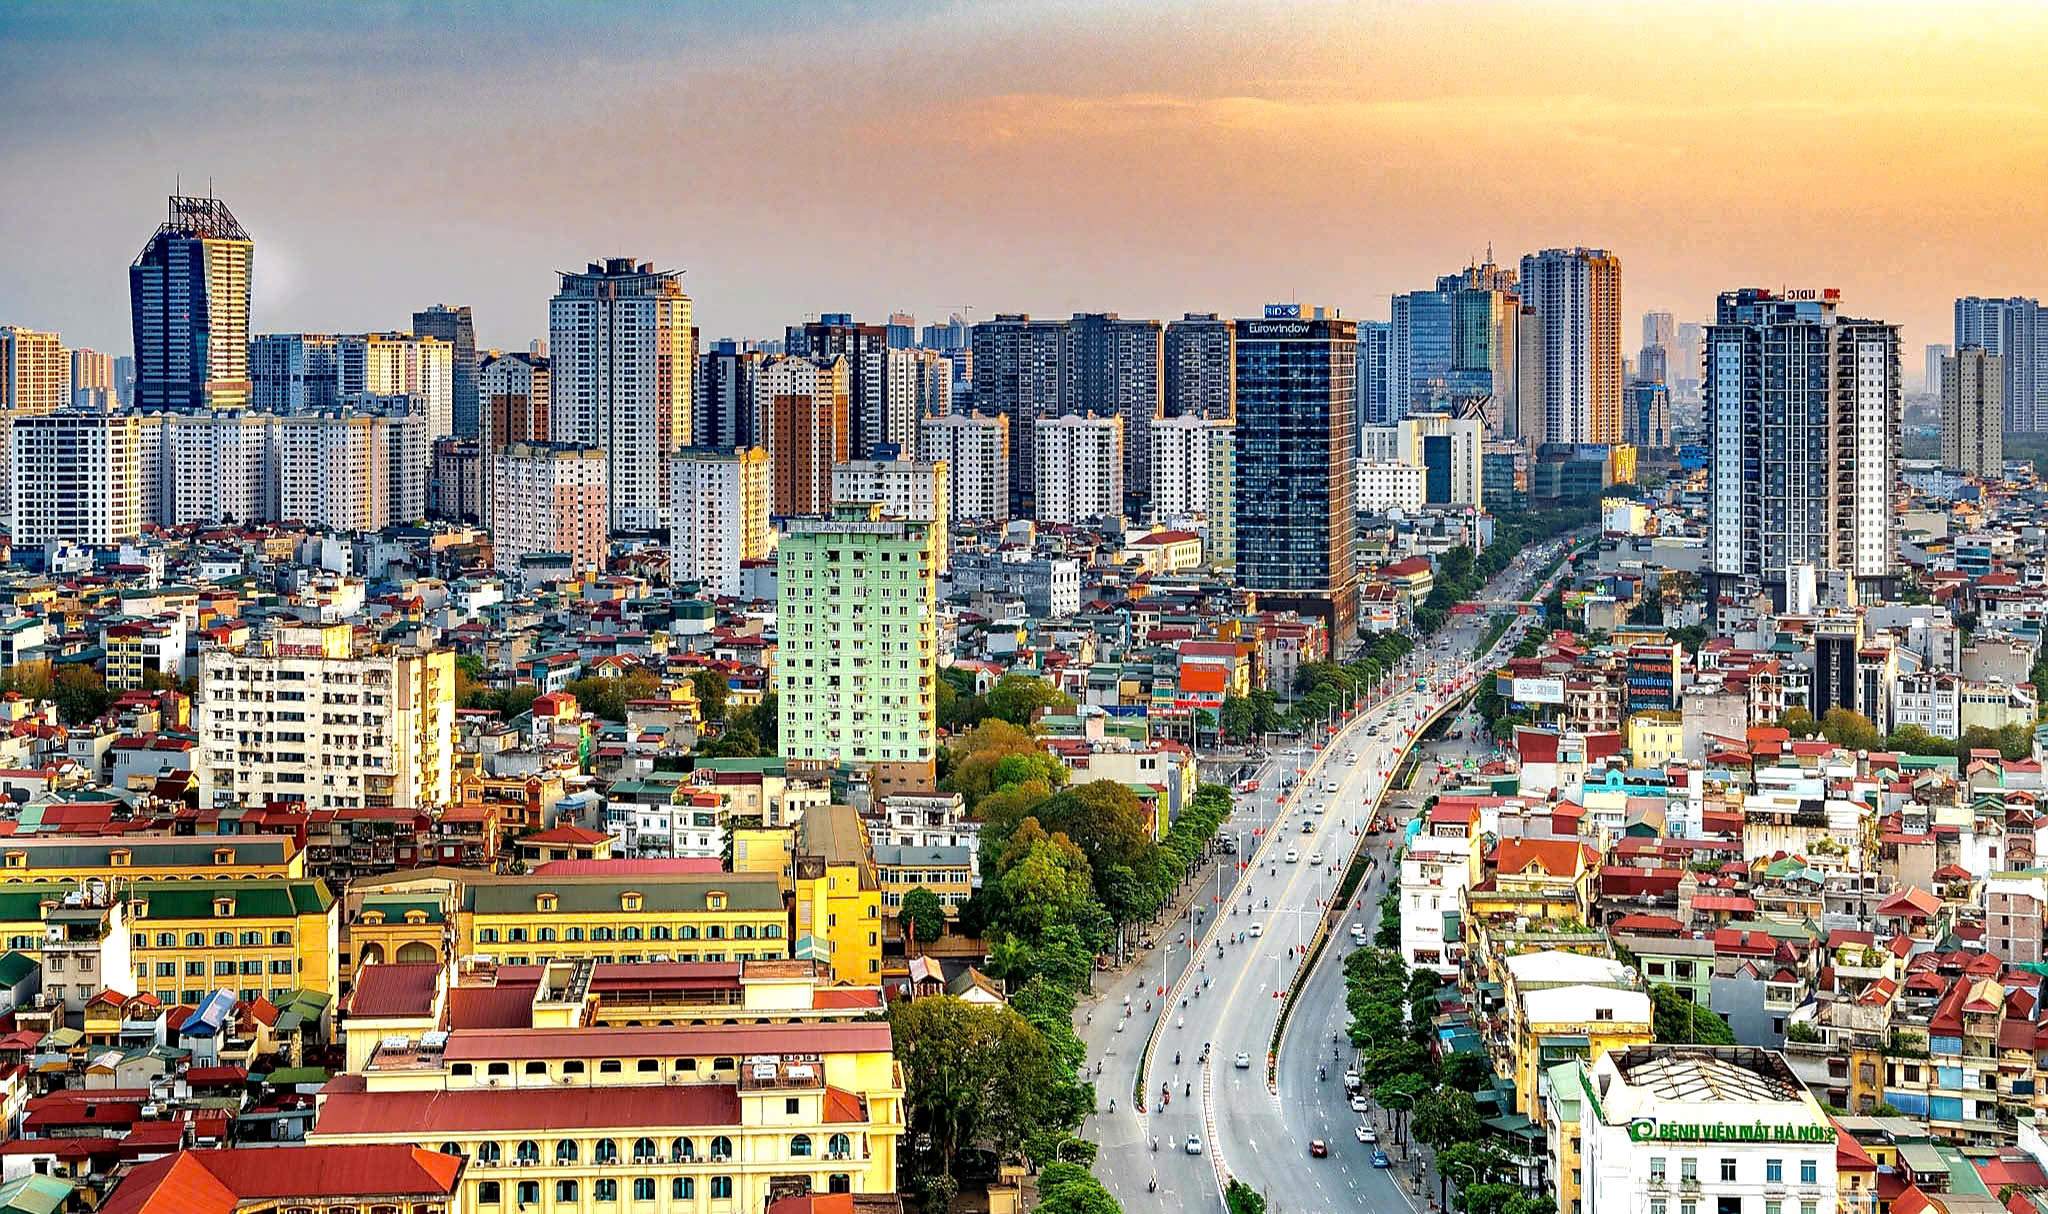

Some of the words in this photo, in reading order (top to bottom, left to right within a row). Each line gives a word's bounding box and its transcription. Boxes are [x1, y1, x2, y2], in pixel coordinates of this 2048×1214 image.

[1249, 323, 1310, 333] Eurowindow
[1659, 1120, 1699, 1140] BỆNH
[1702, 1121, 1736, 1141] VIỆN
[1739, 1119, 1771, 1139] MẮT
[1774, 1122, 1795, 1139] HÀ
